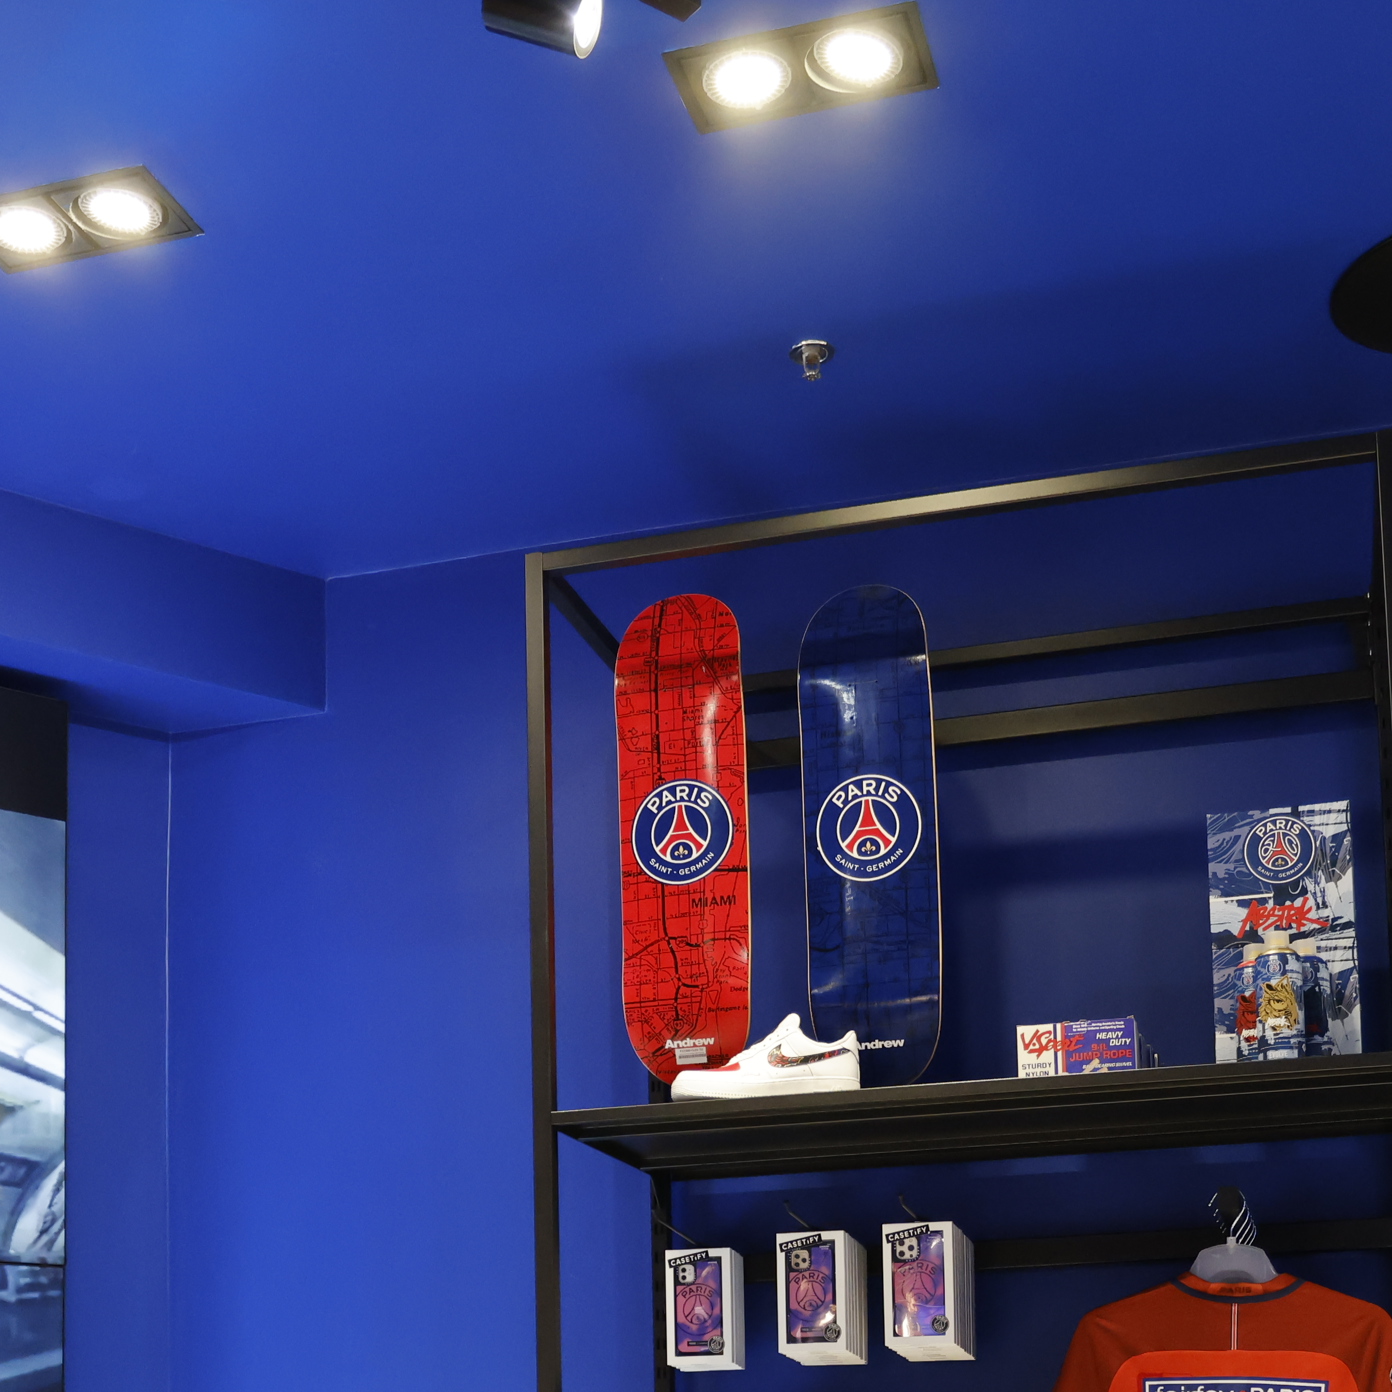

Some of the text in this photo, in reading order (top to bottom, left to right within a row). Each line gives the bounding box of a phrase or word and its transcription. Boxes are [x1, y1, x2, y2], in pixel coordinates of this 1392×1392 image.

[646, 785, 713, 814] PARIS
[831, 779, 901, 809] PARIS
[1255, 819, 1302, 838] PARIS
[649, 858, 673, 875] SAINT
[678, 851, 715, 876] GERMAIN
[834, 854, 859, 872] SAINT
[866, 848, 904, 873] GERMAIN
[691, 894, 736, 909] MIAMI
[1096, 1031, 1123, 1040] HEAVY
[664, 1036, 715, 1049] Andrew
[857, 1038, 905, 1051] Andrew
[1109, 1038, 1131, 1047] DUTY
[1069, 1049, 1133, 1062] JUMP ROPE
[1021, 1062, 1053, 1070] STURDY
[793, 1272, 827, 1285] PARIS
[681, 1286, 714, 1298] PARIS
